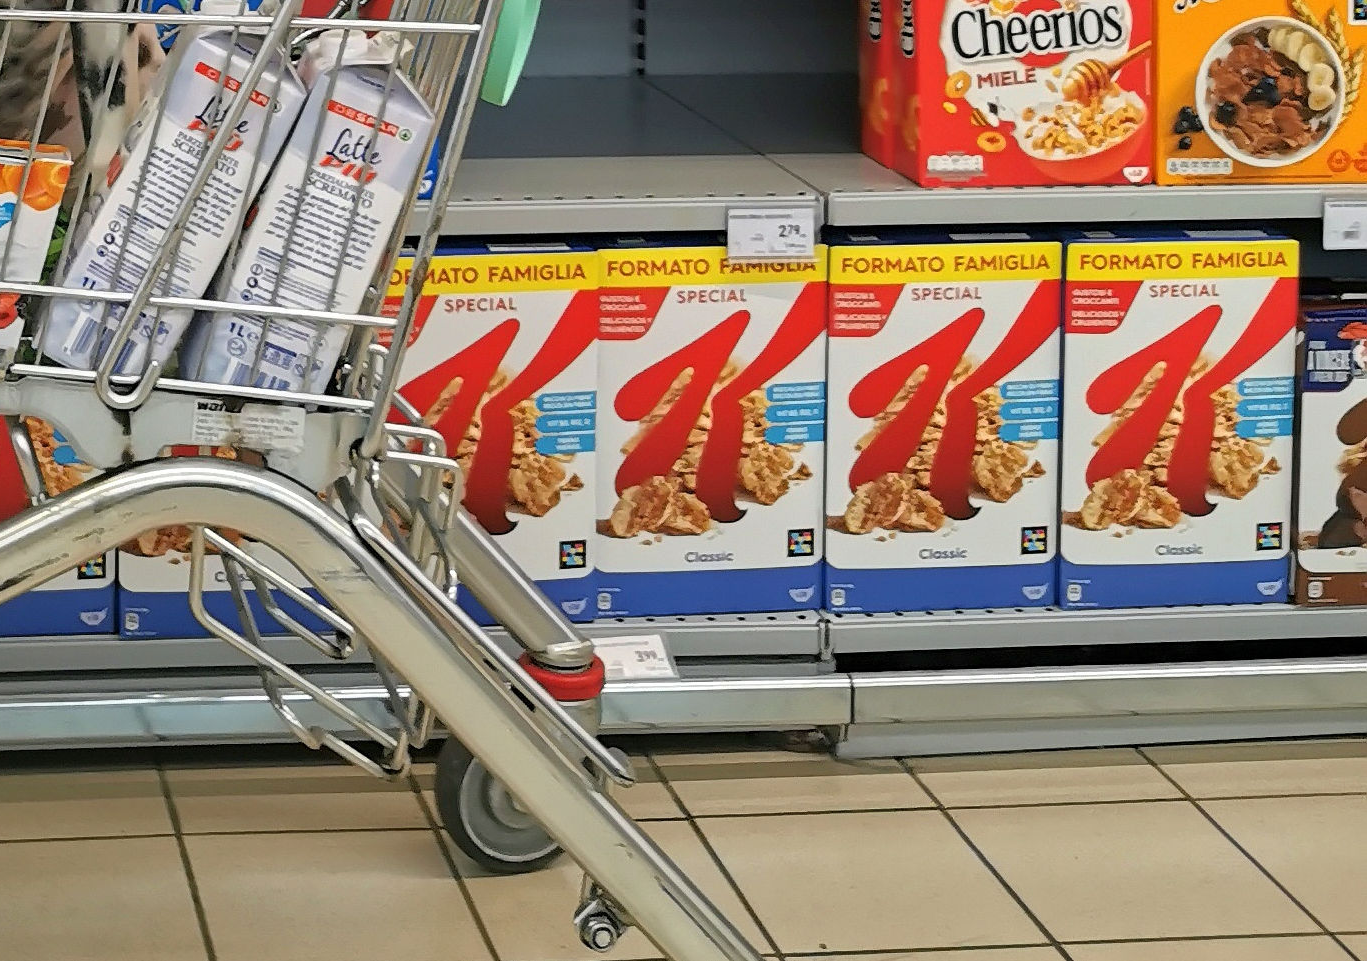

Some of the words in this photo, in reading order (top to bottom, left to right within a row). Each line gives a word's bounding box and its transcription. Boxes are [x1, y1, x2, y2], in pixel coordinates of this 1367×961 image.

[951, 5, 1123, 59] Cheerios
[976, 68, 1038, 89] MIELE
[606, 258, 710, 277] FORMATO
[841, 255, 945, 274] FORMATO
[953, 253, 1051, 272] FAMIGLIA
[1079, 253, 1183, 271] FORMATO
[1191, 251, 1288, 269] FAMIGLIA
[488, 264, 587, 283] FAMIGLIA
[676, 288, 747, 304] SPECIAL
[910, 286, 982, 302] SPECIAL
[1148, 283, 1220, 298] SPECIAL
[444, 296, 518, 314] SPECIAL
[684, 551, 734, 563] Classic
[918, 547, 967, 561] Classic
[1154, 543, 1204, 557] Classic
